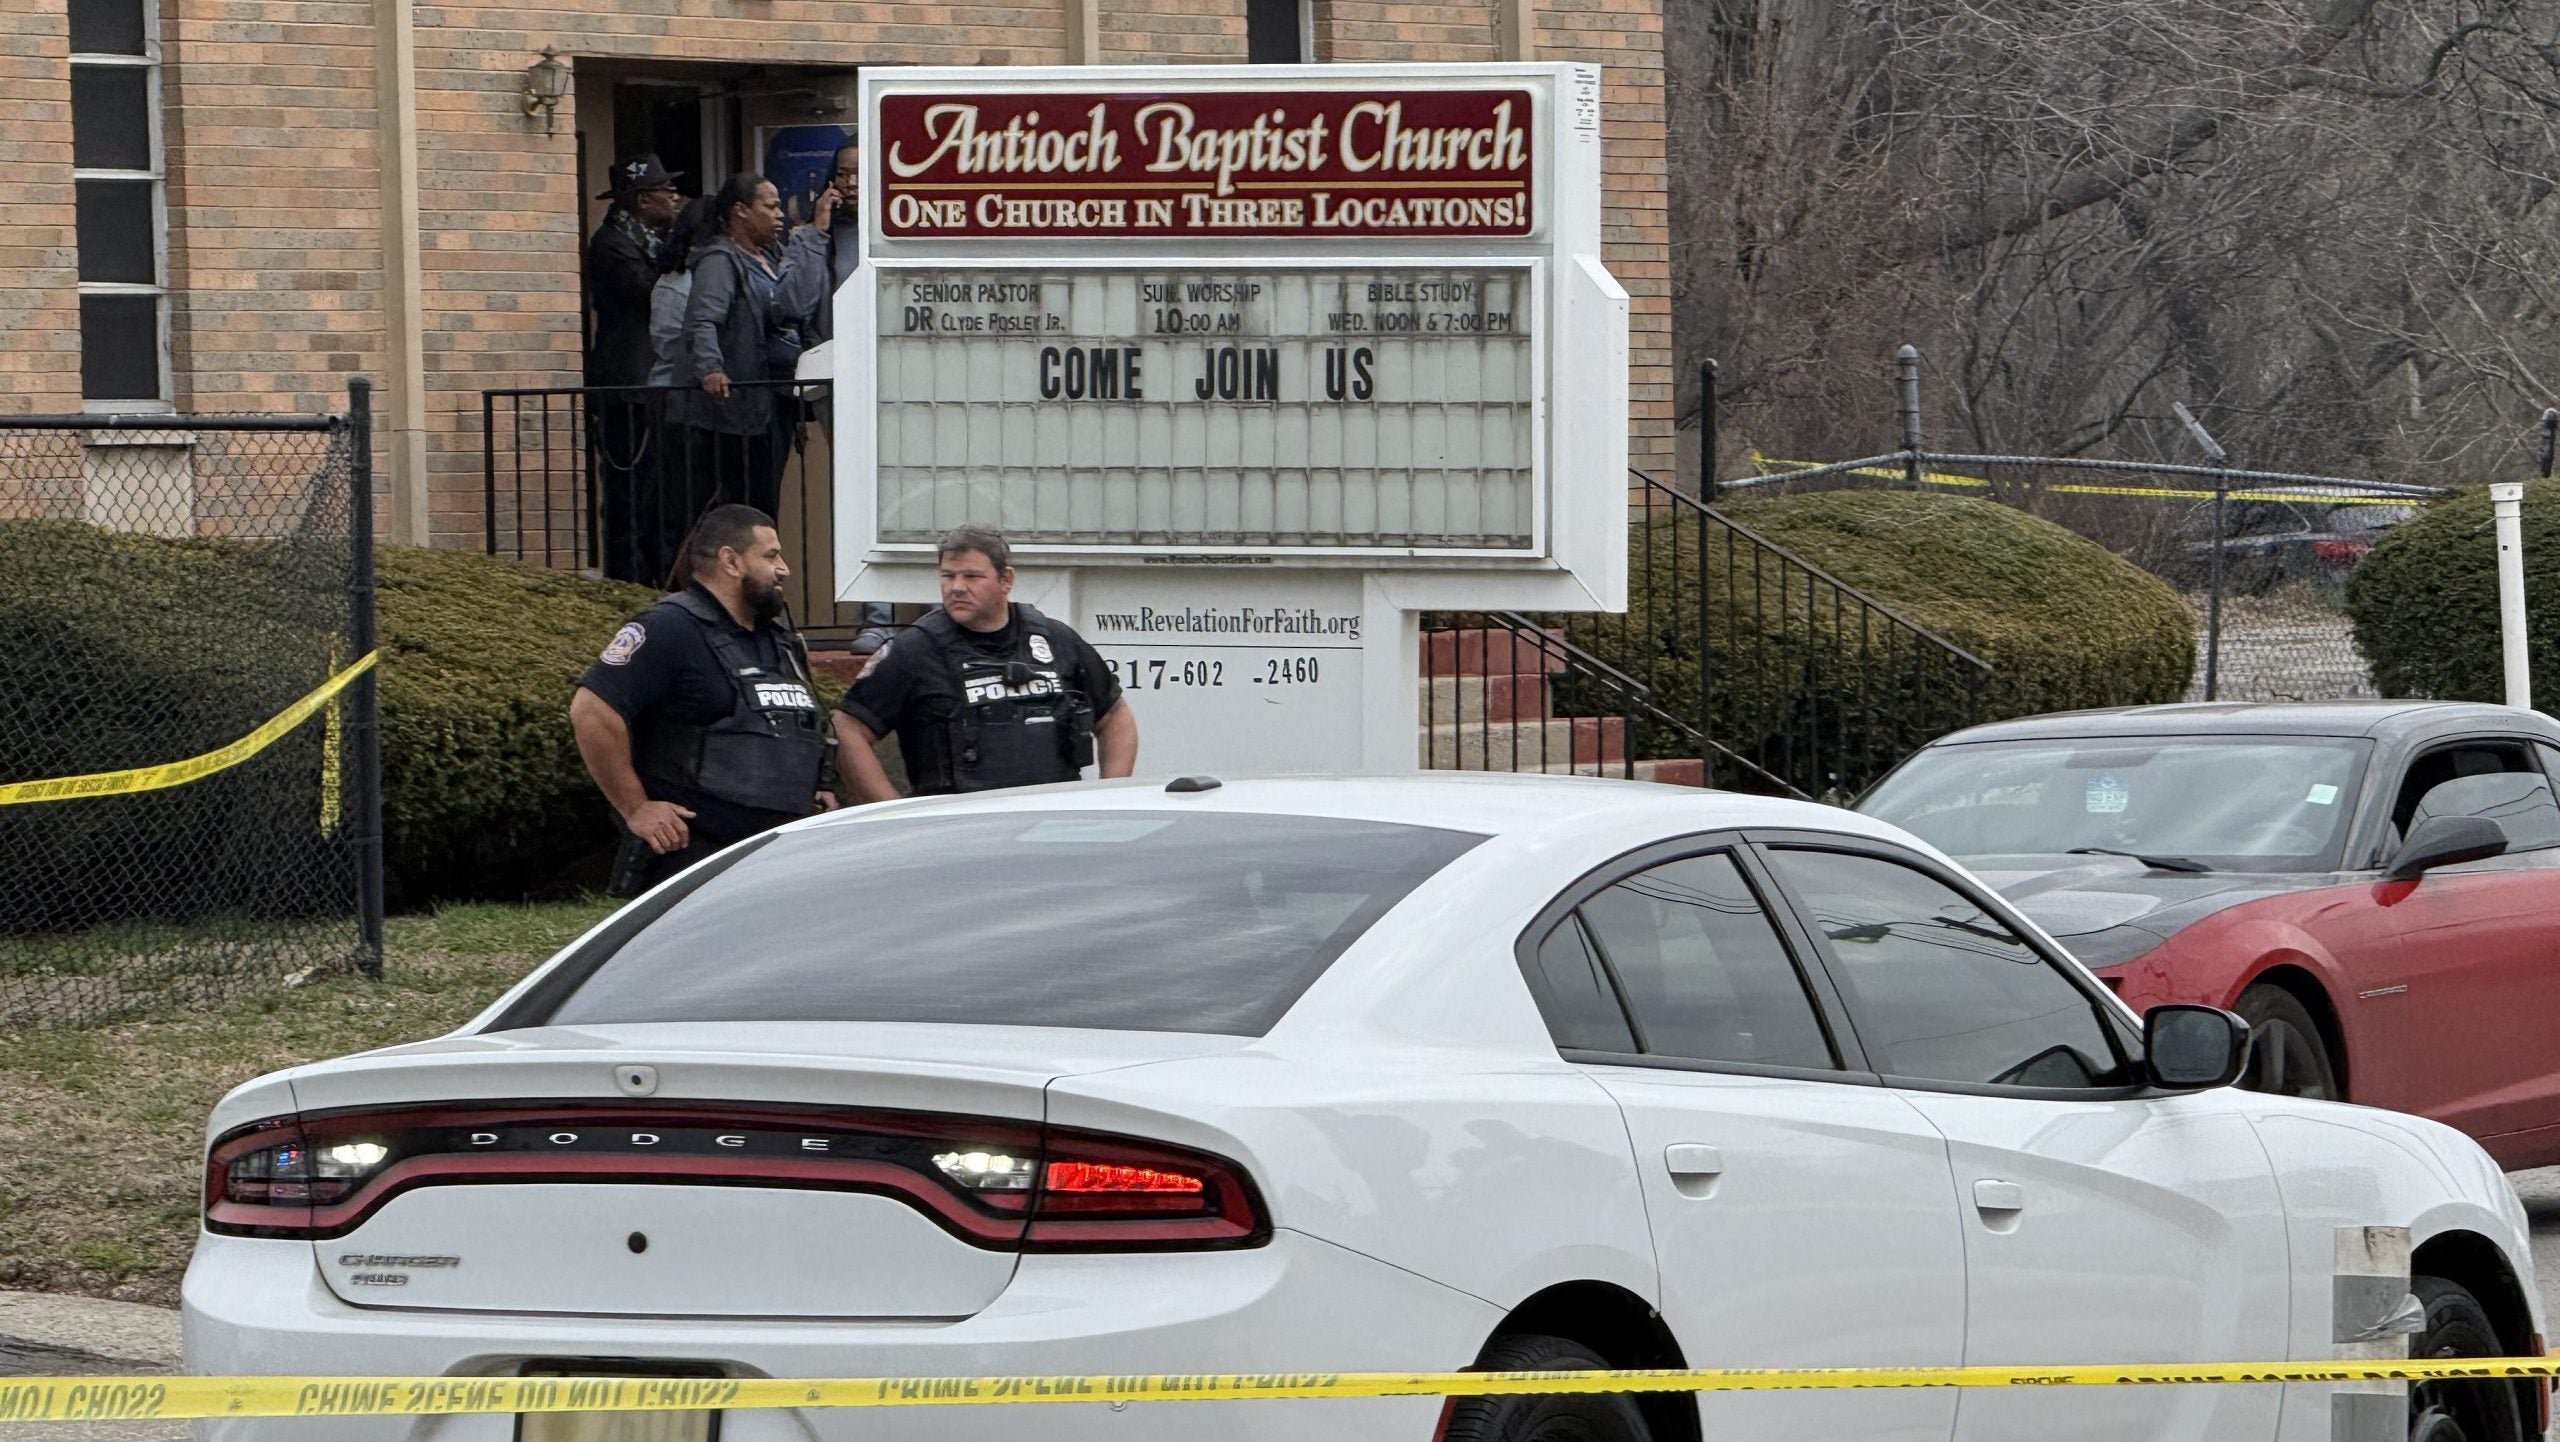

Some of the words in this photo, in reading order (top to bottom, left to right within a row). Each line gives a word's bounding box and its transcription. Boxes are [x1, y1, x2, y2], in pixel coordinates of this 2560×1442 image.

[889, 103, 1121, 177] Antioch
[1134, 102, 1329, 196] Baptist
[1339, 99, 1527, 172] Church
[889, 194, 967, 228] ONE
[976, 193, 1126, 228] CHURCH
[1135, 199, 1174, 228] IN
[1182, 193, 1304, 228] THREE
[1311, 191, 1526, 228] LOCATIONS!
[912, 284, 972, 303] SENIOR
[978, 283, 1039, 303] PASTOR
[1187, 284, 1261, 303] WORSHIP
[1368, 283, 1415, 302] BIBLE
[1420, 282, 1473, 302] STUDY
[904, 306, 933, 332] DR
[941, 313, 984, 331] CLYDE
[1154, 308, 1211, 333] 10:00
[1217, 313, 1241, 331] AM
[1328, 313, 1368, 331] WED.
[1376, 313, 1420, 331] NOON
[1427, 313, 1438, 331] &
[1441, 313, 1482, 331] 7:00
[1488, 312, 1512, 331] PM
[1039, 347, 1143, 400] COME
[1195, 347, 1279, 401] JOIN
[1326, 347, 1374, 401] US
[1095, 606, 1361, 640] www.RevelationForFaith.org
[966, 679, 1063, 704] POLICE
[471, 1132, 830, 1151] DODGE
